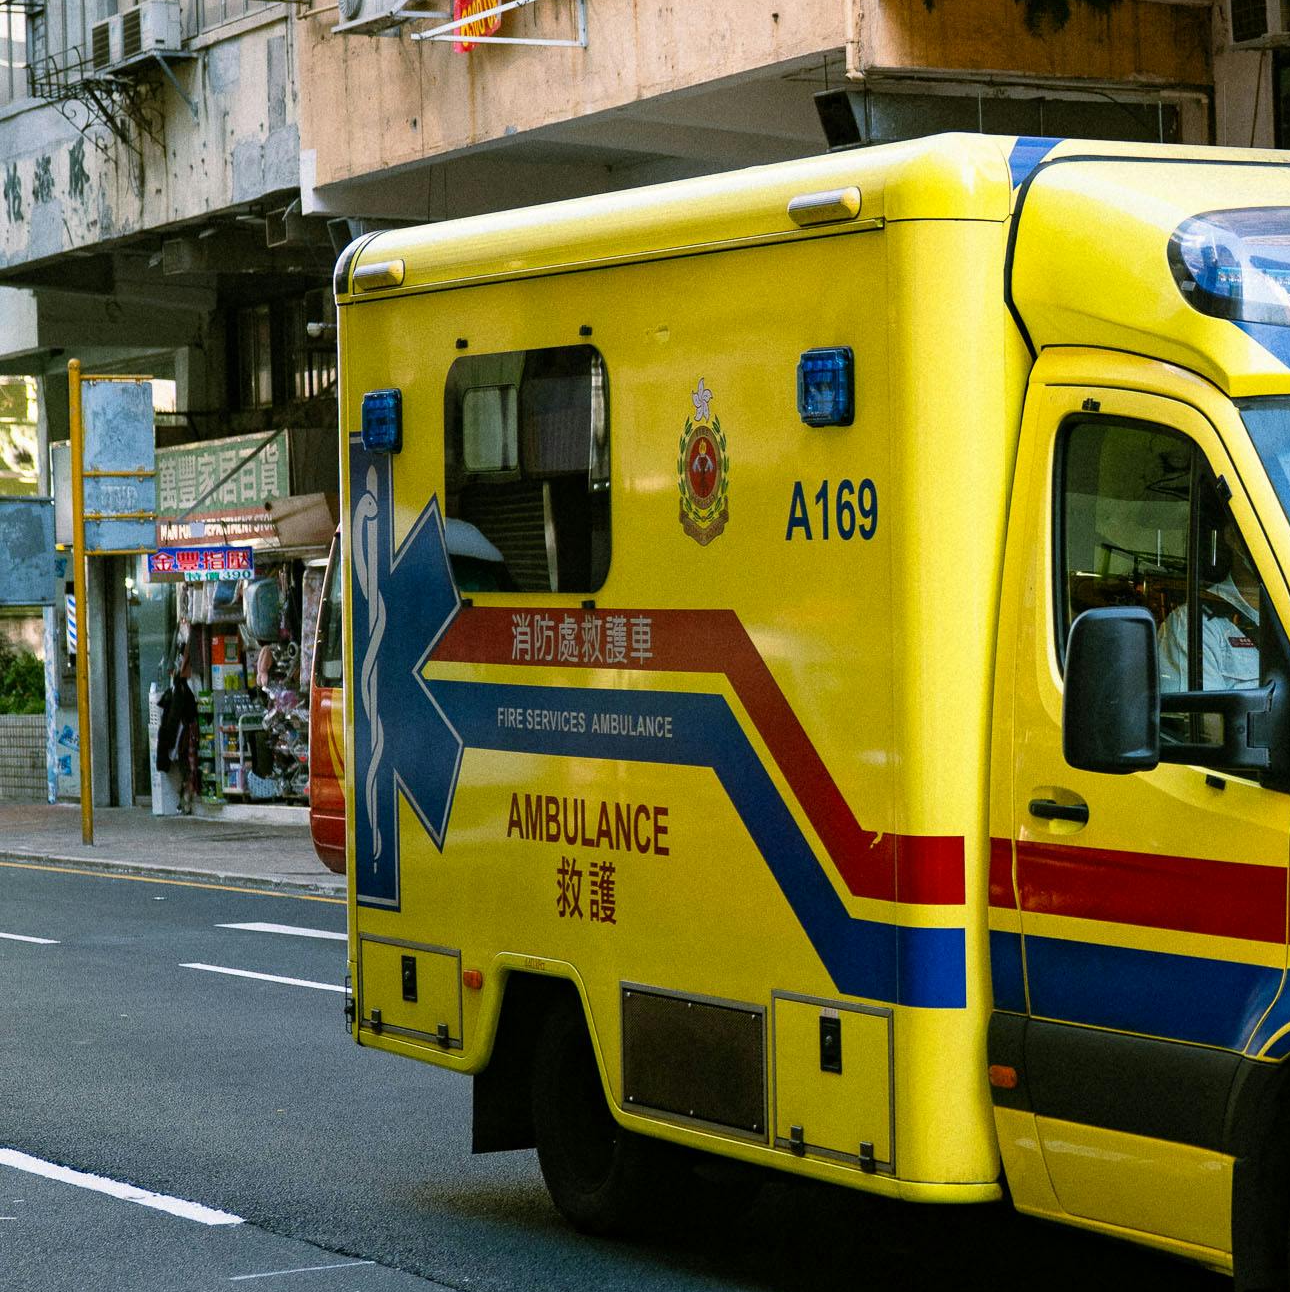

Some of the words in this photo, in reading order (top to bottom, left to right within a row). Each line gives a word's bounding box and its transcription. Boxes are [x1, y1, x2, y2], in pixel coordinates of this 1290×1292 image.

[159, 443, 280, 511] 萬豐家居百貨
[785, 478, 878, 541] A169
[223, 570, 251, 580] 390
[511, 612, 653, 665] 消防處救護車
[497, 707, 523, 728] FIRE
[526, 709, 585, 733] SERVICES
[591, 712, 673, 738] AMBULANCE
[507, 792, 670, 856] AMBULANCE
[556, 855, 617, 924] 救護
